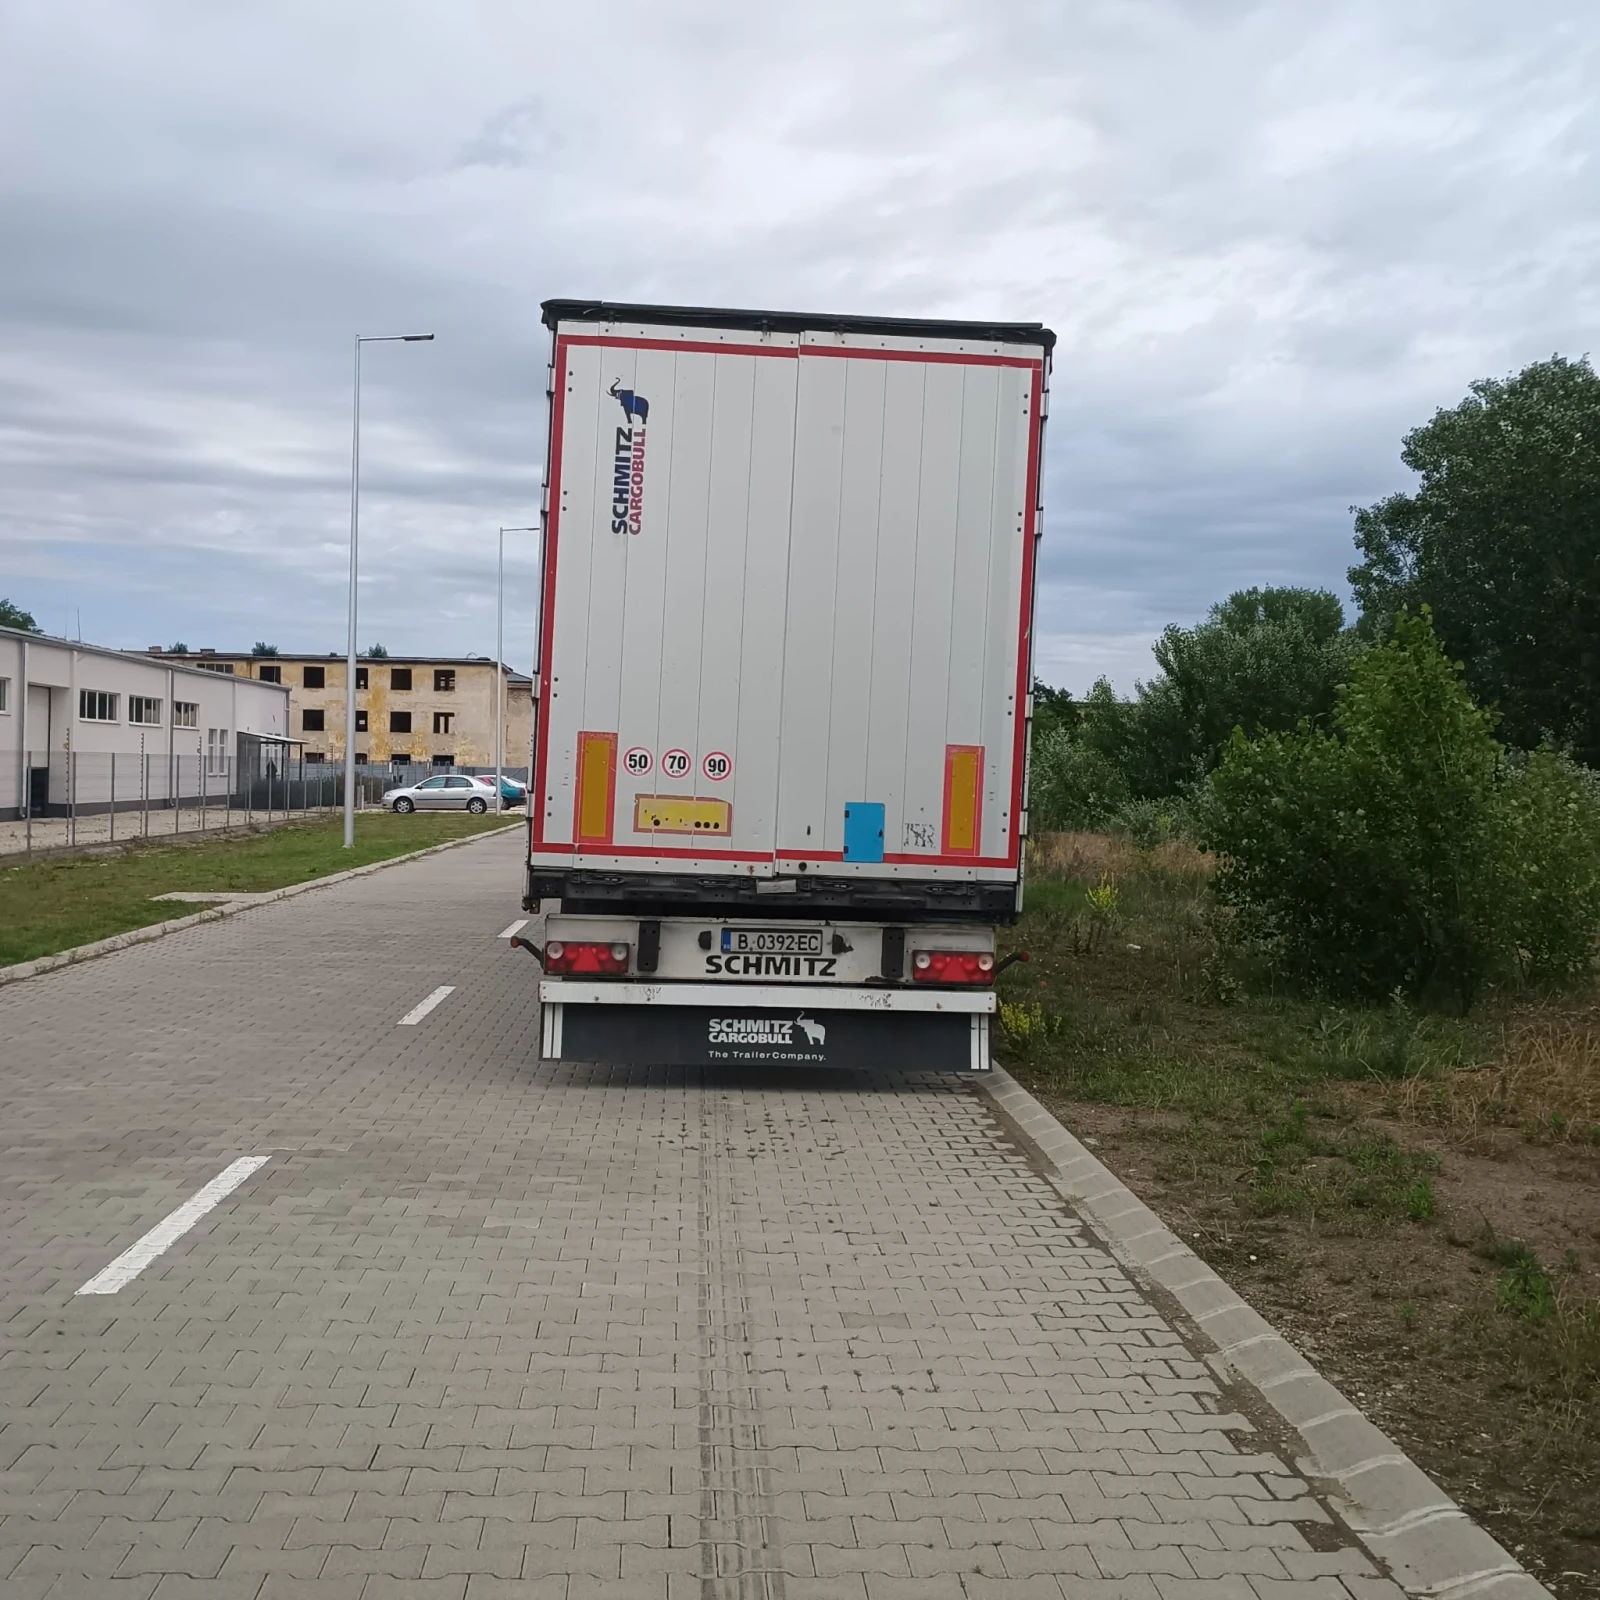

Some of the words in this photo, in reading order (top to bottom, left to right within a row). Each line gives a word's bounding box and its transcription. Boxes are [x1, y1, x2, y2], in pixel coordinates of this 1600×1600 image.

[612, 427, 632, 534] SCHMITZ
[629, 429, 646, 535] CARGOBULL
[628, 754, 648, 769] 50
[668, 755, 687, 770] 70
[708, 758, 727, 773] 90
[705, 955, 837, 976] SCHMITZ
[708, 1018, 793, 1033] SCHMITZ
[708, 1032, 793, 1044] CARGOBULL
[708, 1050, 729, 1058] The
[732, 1051, 770, 1059] Trailer
